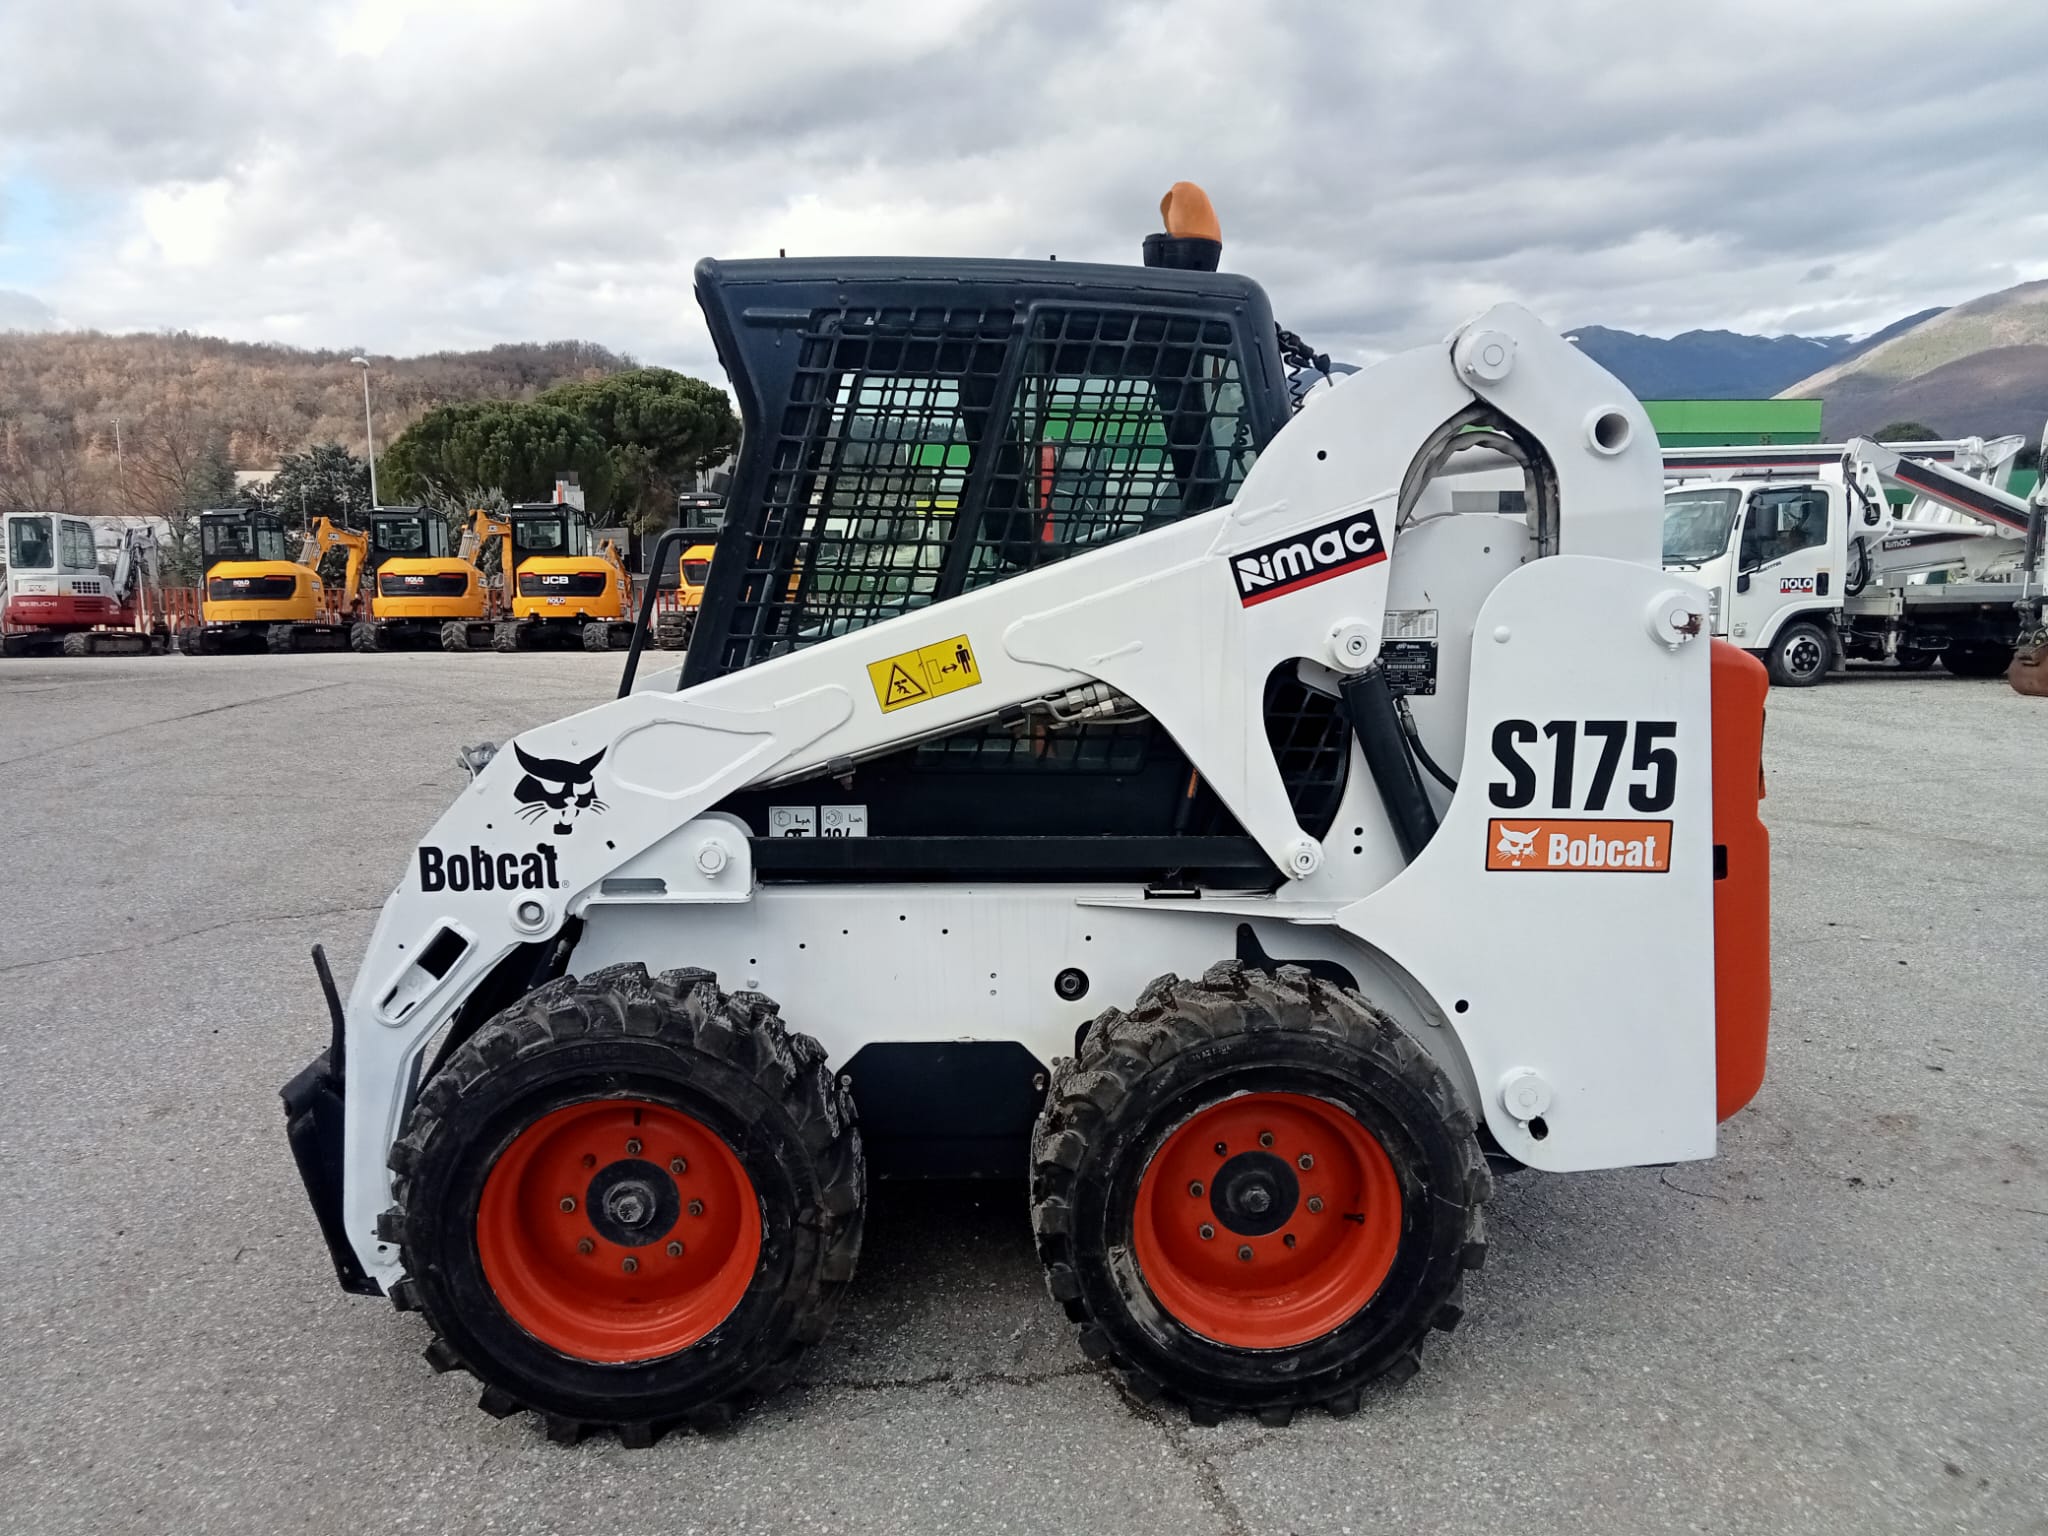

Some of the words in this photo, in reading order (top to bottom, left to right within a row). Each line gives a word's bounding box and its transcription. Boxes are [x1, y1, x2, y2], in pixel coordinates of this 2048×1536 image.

[1236, 521, 1375, 593] Rimac
[1884, 538, 1912, 550] Rimac
[542, 576, 569, 584] JCB
[1488, 719, 1678, 813] S175
[418, 843, 560, 892] Bobcat
[1547, 833, 1657, 867] Bobcat
